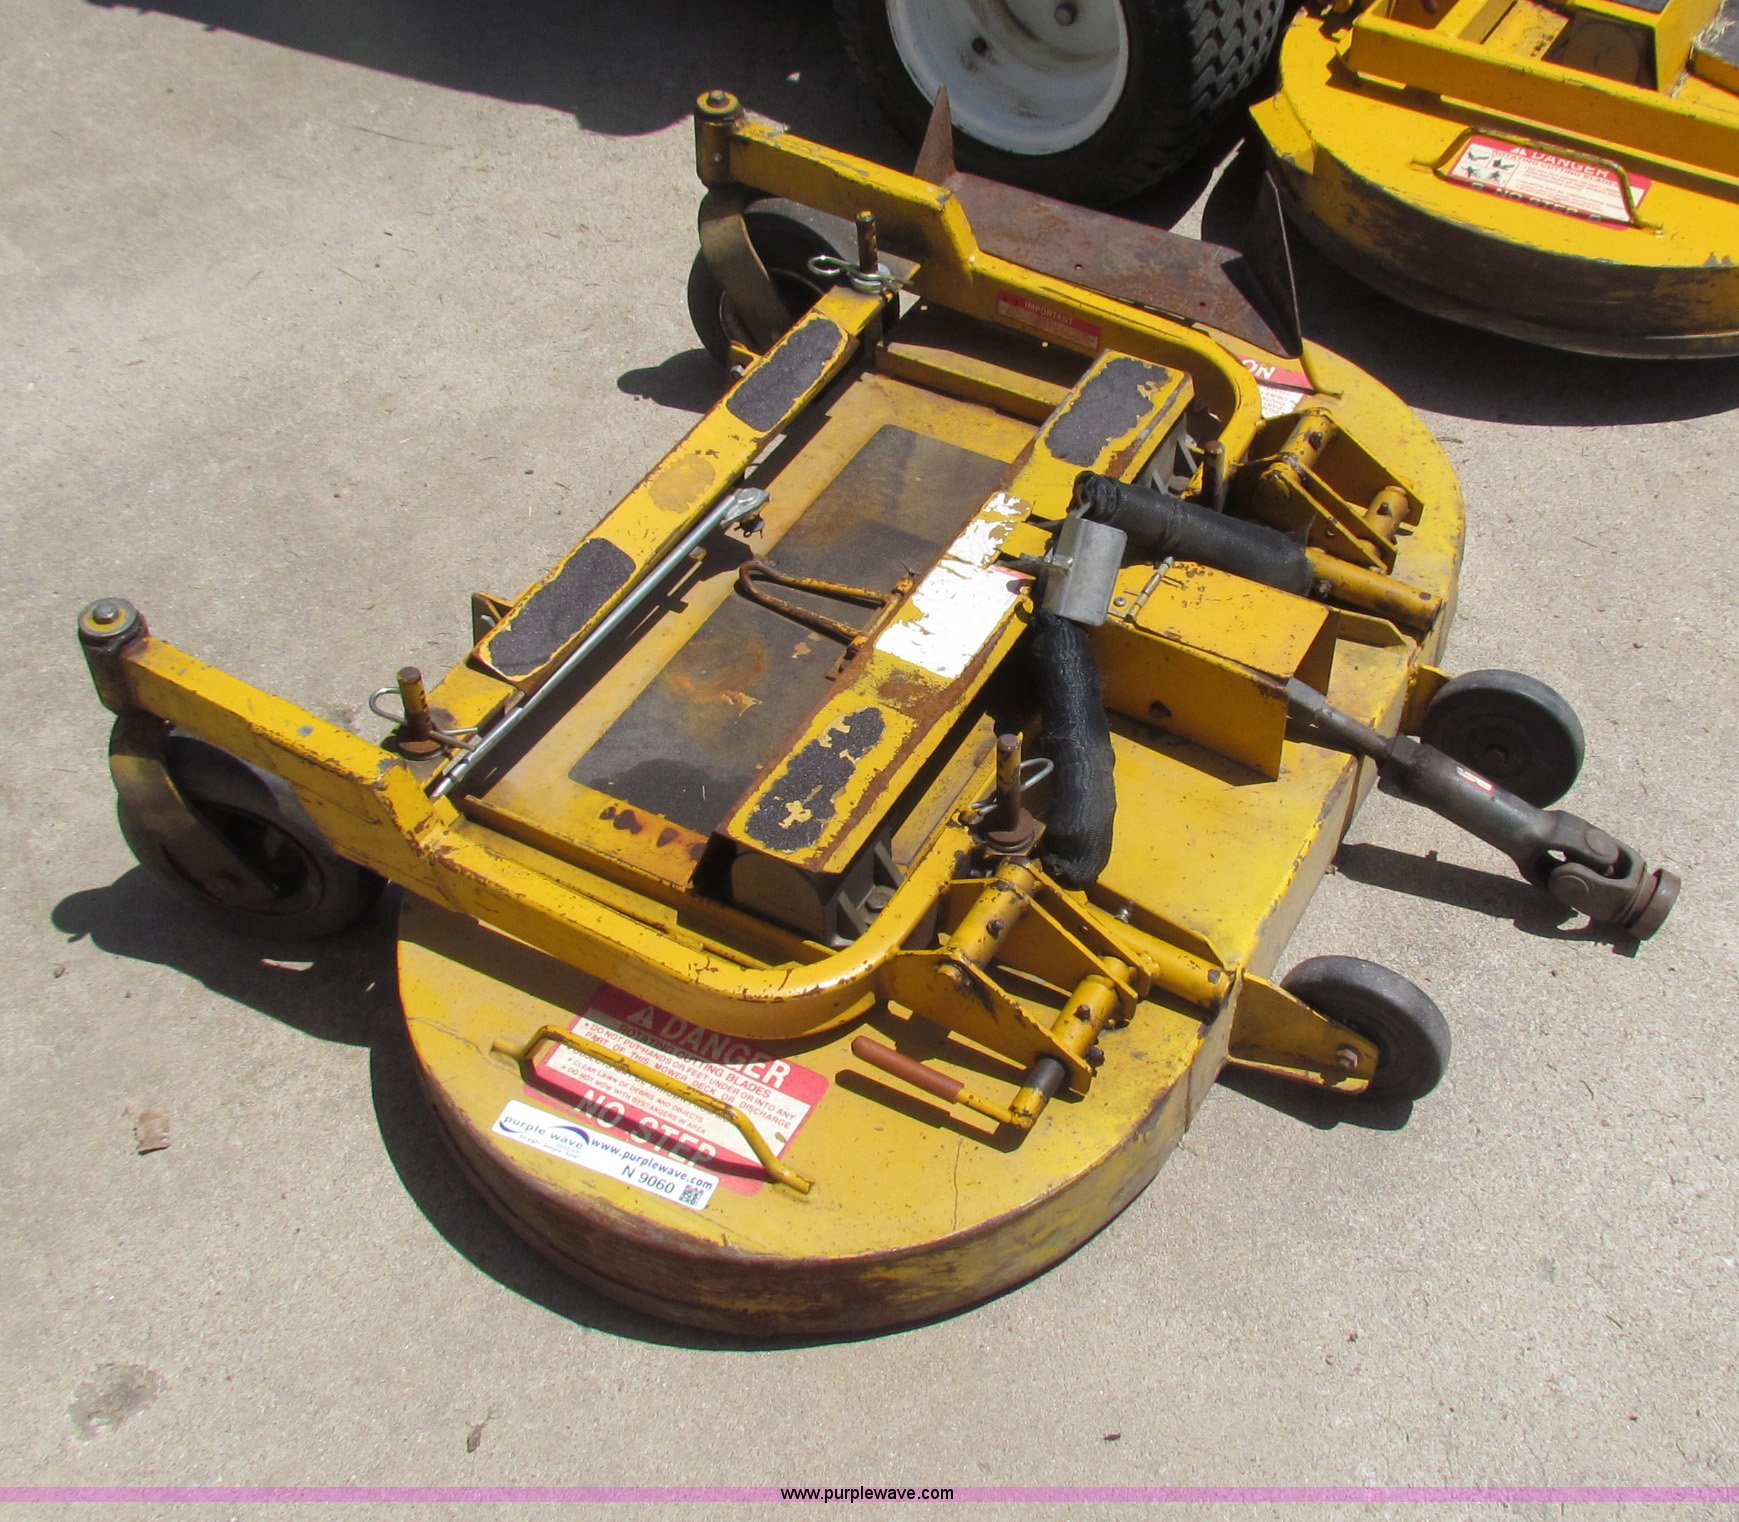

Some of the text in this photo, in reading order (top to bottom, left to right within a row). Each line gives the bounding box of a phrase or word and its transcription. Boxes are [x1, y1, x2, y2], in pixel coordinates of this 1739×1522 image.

[585, 1031, 608, 1044] PART
[612, 1043, 626, 1053] OF
[630, 1051, 651, 1065] THIS
[655, 1063, 688, 1081] MOWER
[691, 1080, 716, 1095] DECK
[721, 1093, 735, 1103] OR
[739, 1101, 792, 1130] DISCHARGE
[590, 1024, 604, 1034] DO
[605, 1029, 623, 1042] NOT
[642, 1047, 671, 1065] HANDS
[686, 1067, 709, 1081] FEET
[709, 1076, 740, 1096] UNDER
[740, 1092, 754, 1102] OR
[754, 1098, 776, 1112] INTO
[777, 1108, 797, 1121] ANY
[619, 1024, 772, 1099] ROTATING CUTTING BLADES
[660, 1014, 791, 1089] DANGER
[568, 1067, 579, 1076] DO
[595, 1079, 611, 1091] MOW
[613, 1087, 631, 1100] WITH
[687, 1120, 706, 1134] AREA
[573, 1059, 597, 1074] CLEAR
[597, 1070, 617, 1083] LAWN
[619, 1080, 629, 1088] OF
[630, 1085, 655, 1100] DEBRIS
[656, 1097, 671, 1108] AND
[672, 1105, 703, 1123] OBJECTS
[503, 1116, 546, 1135] purple
[550, 1133, 583, 1149] wave
[574, 1089, 625, 1128] NO
[630, 1116, 717, 1168] STEP
[591, 1138, 713, 1190] www.purplewave.com
[621, 1165, 675, 1194] N 9060
